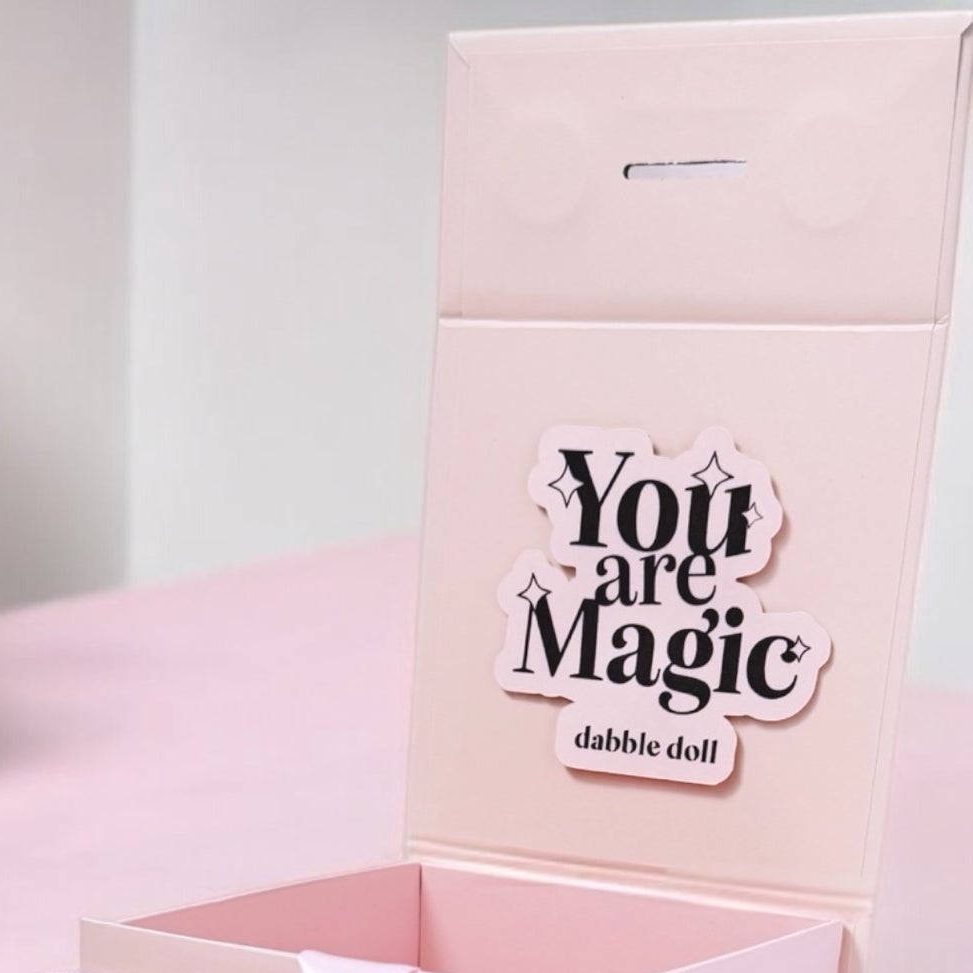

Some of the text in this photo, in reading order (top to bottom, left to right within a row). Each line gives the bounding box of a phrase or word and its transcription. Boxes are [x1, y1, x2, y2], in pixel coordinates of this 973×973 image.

[558, 448, 752, 558] You
[595, 553, 717, 607] are
[512, 595, 799, 715] Magic
[574, 725, 718, 764] dabble doll
